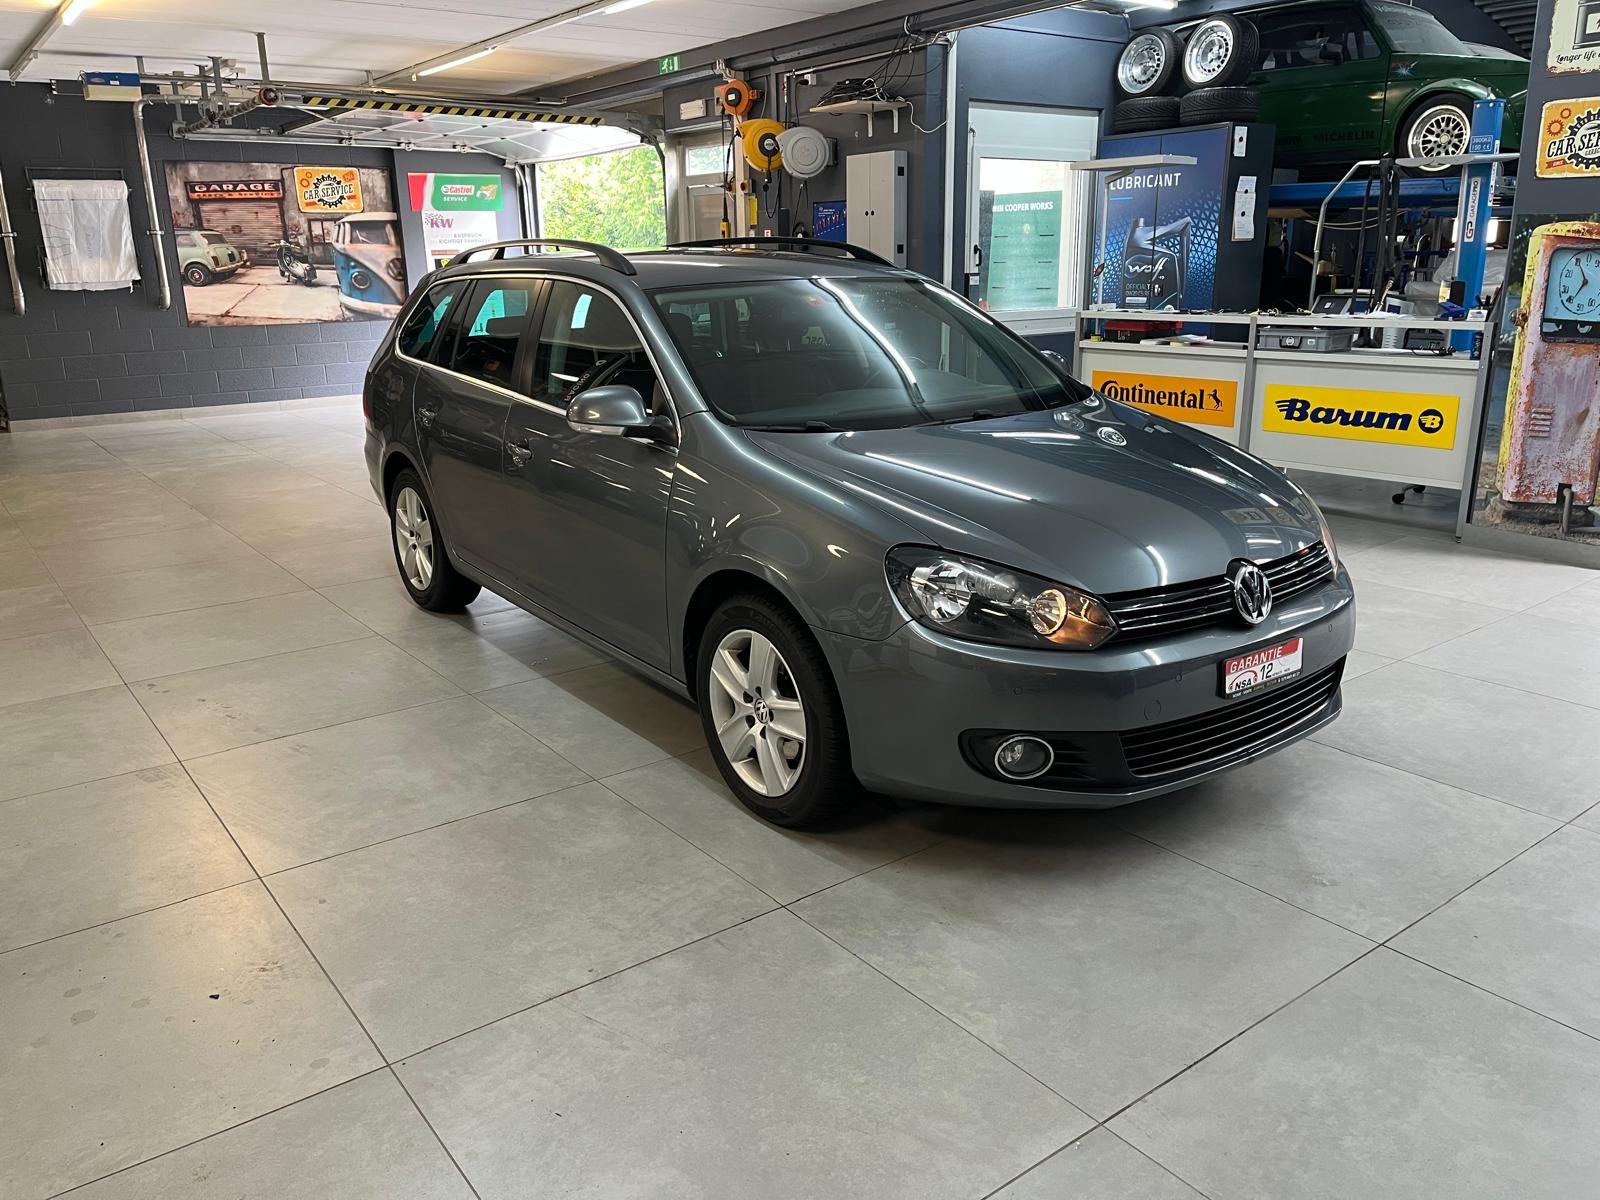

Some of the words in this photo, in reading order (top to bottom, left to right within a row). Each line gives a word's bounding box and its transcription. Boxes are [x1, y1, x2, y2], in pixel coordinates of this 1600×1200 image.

[1556, 54, 1582, 64] Longer
[1584, 50, 1597, 61] life
[1313, 130, 1375, 142] MICHELIN
[1547, 137, 1576, 158] CAR
[194, 183, 275, 192] GARAGE
[1110, 172, 1182, 190] LUBRICANT
[303, 190, 320, 201] CAR
[320, 183, 354, 197] SERVICE
[449, 186, 473, 194] Castrol
[1005, 202, 1029, 212] COOPER
[1030, 201, 1054, 211] WORKS
[430, 218, 454, 228] KW
[1100, 378, 1205, 411] Continental
[1276, 397, 1412, 431] Barum
[1230, 646, 1283, 673] GARANTIE
[1260, 662, 1274, 680] 12
[1235, 678, 1252, 691] NSA
